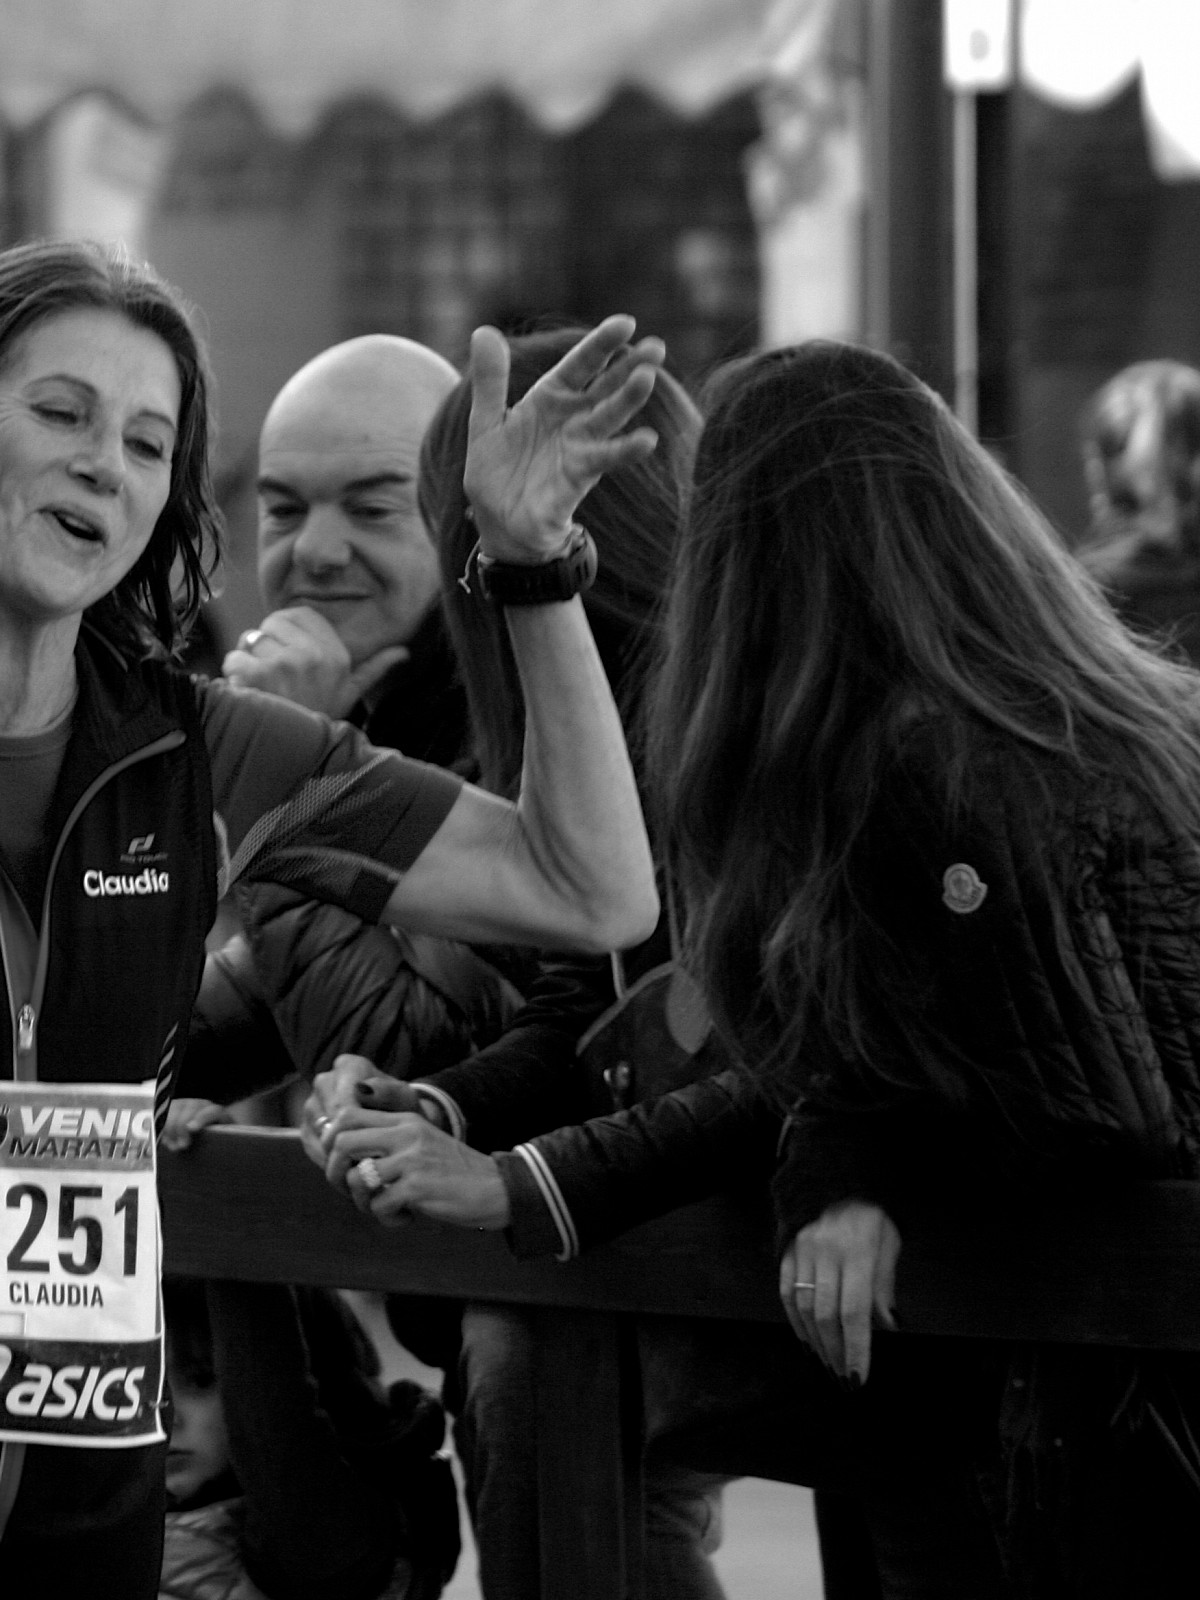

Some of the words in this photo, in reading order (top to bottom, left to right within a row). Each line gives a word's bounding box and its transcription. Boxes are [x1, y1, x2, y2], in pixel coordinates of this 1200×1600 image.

[83, 867, 169, 897] Claudia
[18, 1105, 153, 1139] VENIC
[9, 1281, 104, 1308] CLAUDIA
